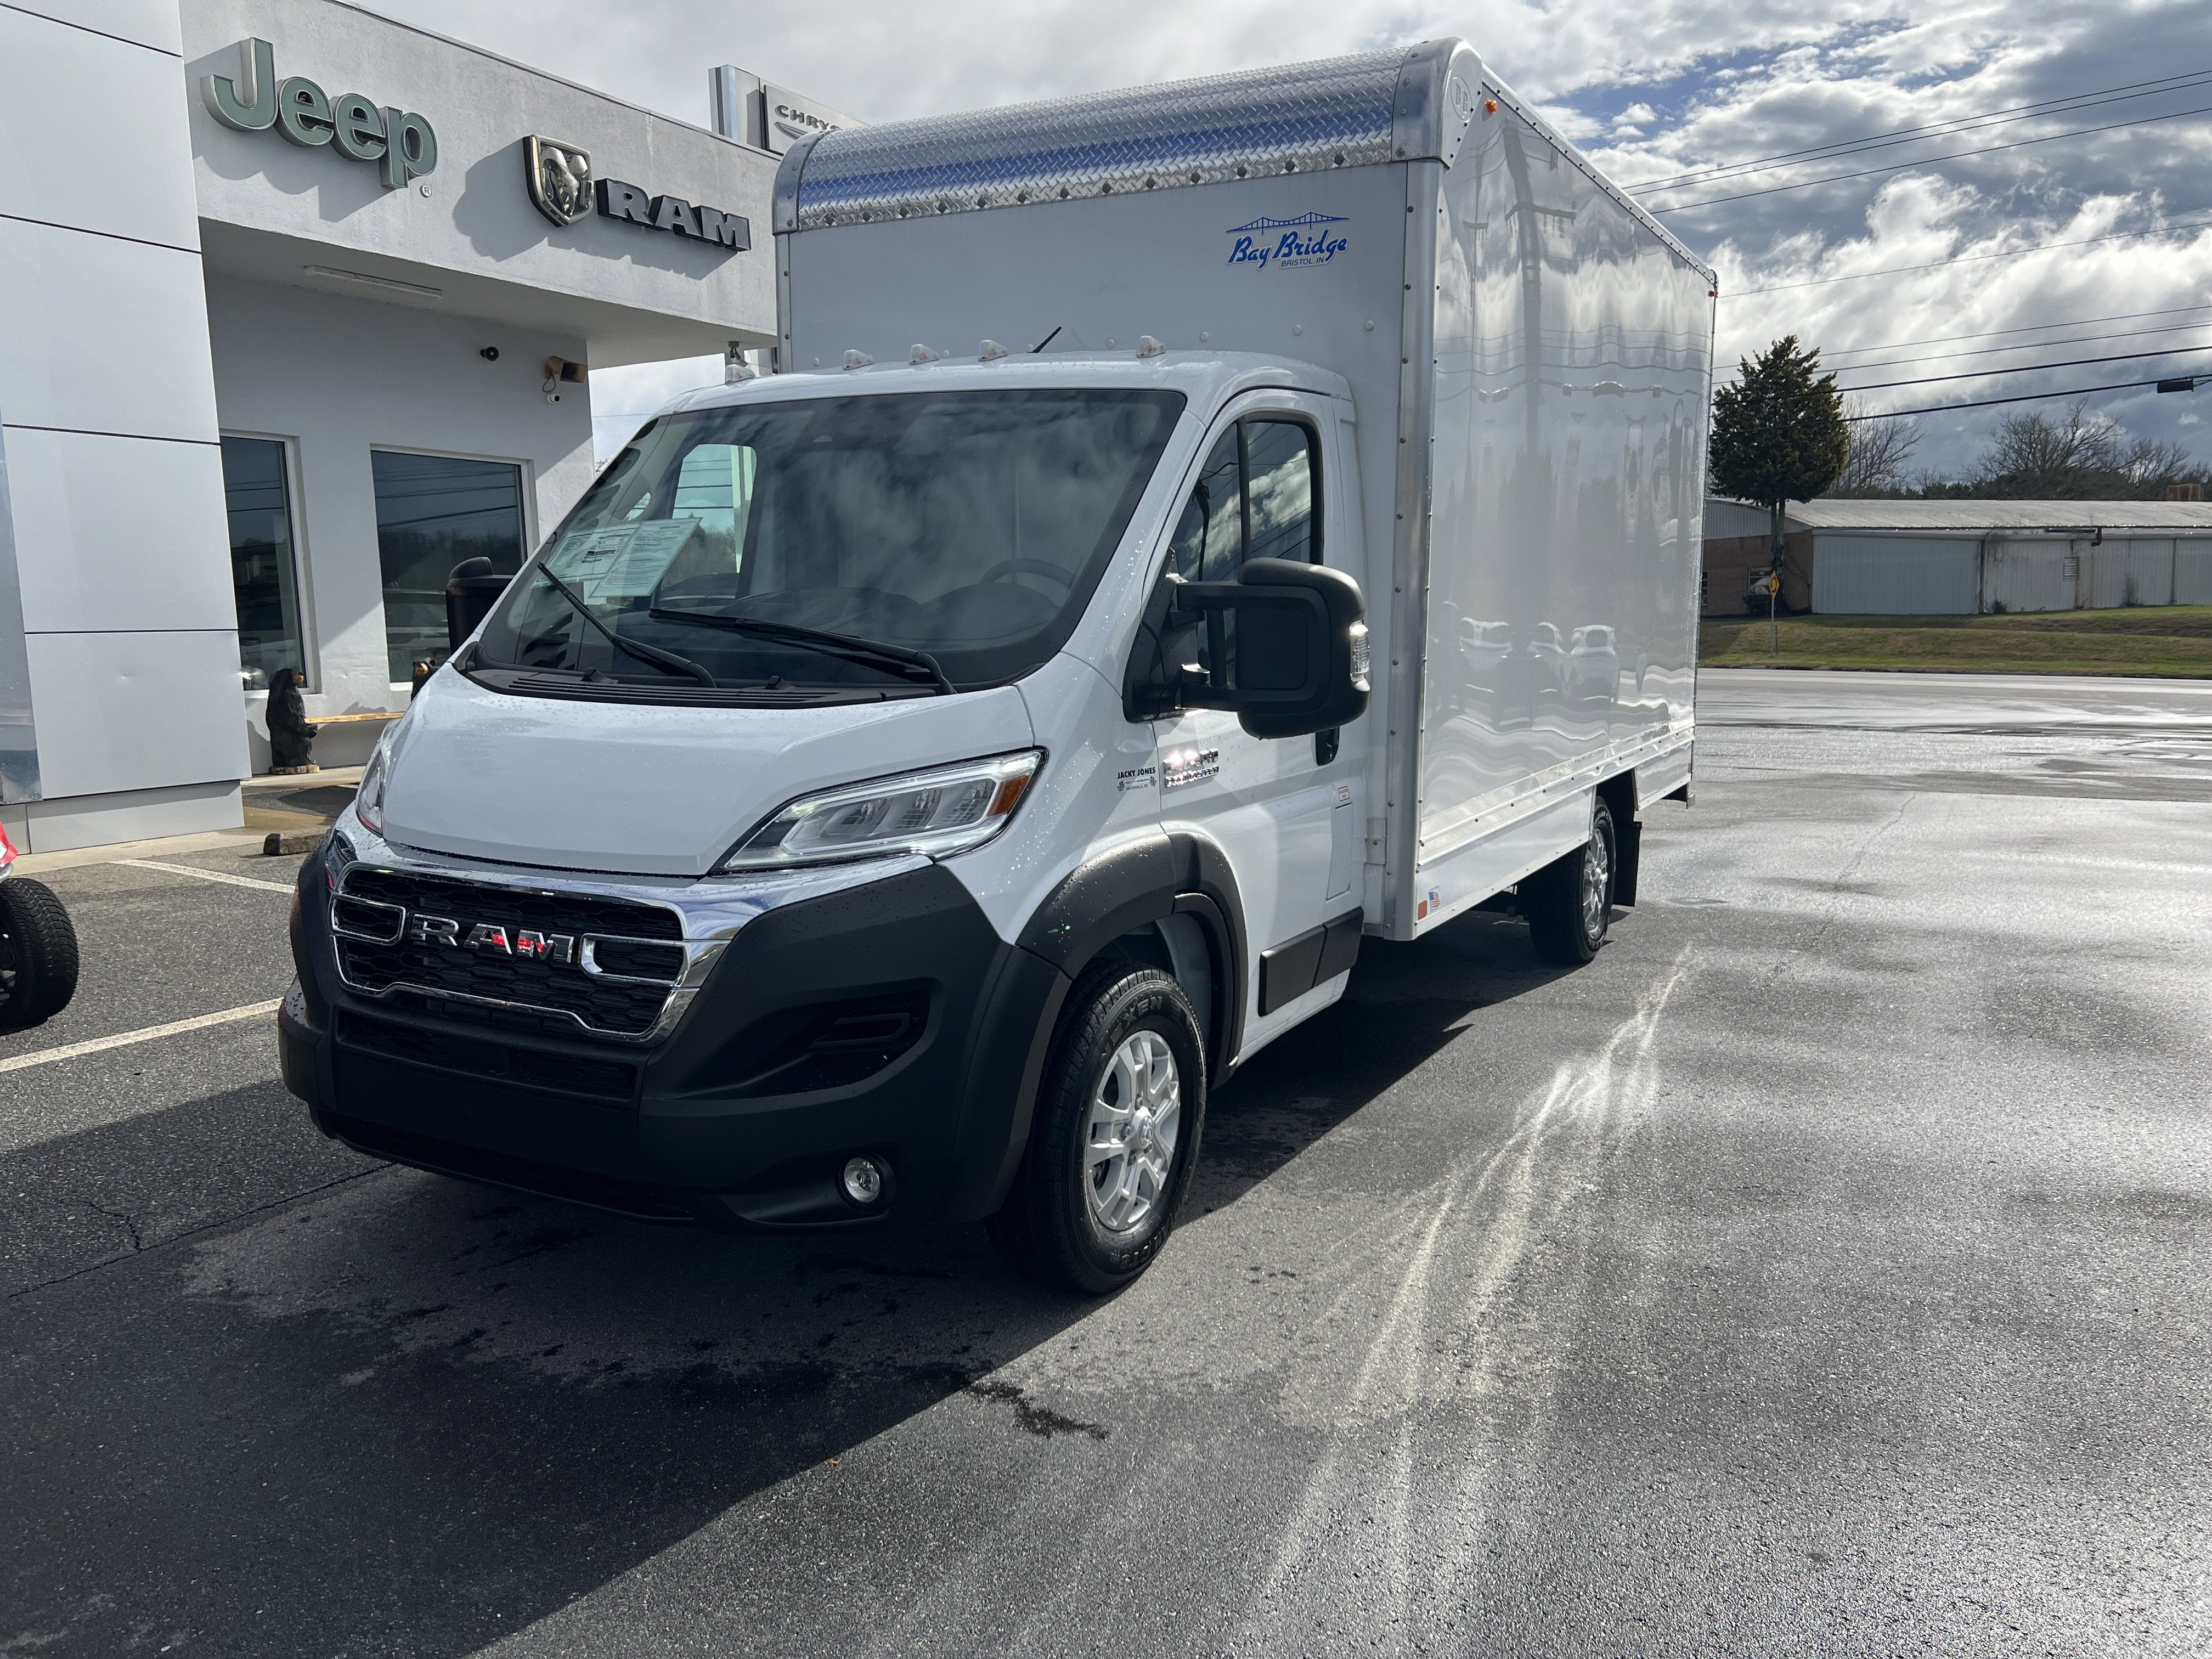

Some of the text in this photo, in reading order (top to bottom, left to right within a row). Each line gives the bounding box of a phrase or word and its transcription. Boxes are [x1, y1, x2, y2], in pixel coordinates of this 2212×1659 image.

[200, 37, 438, 189] Jeep
[774, 104, 841, 131] CHRY
[595, 178, 751, 252] RAM
[1228, 229, 1348, 270] Bay Bridge
[1117, 766, 1156, 780] JACKY JONES
[411, 913, 574, 963] RAM
